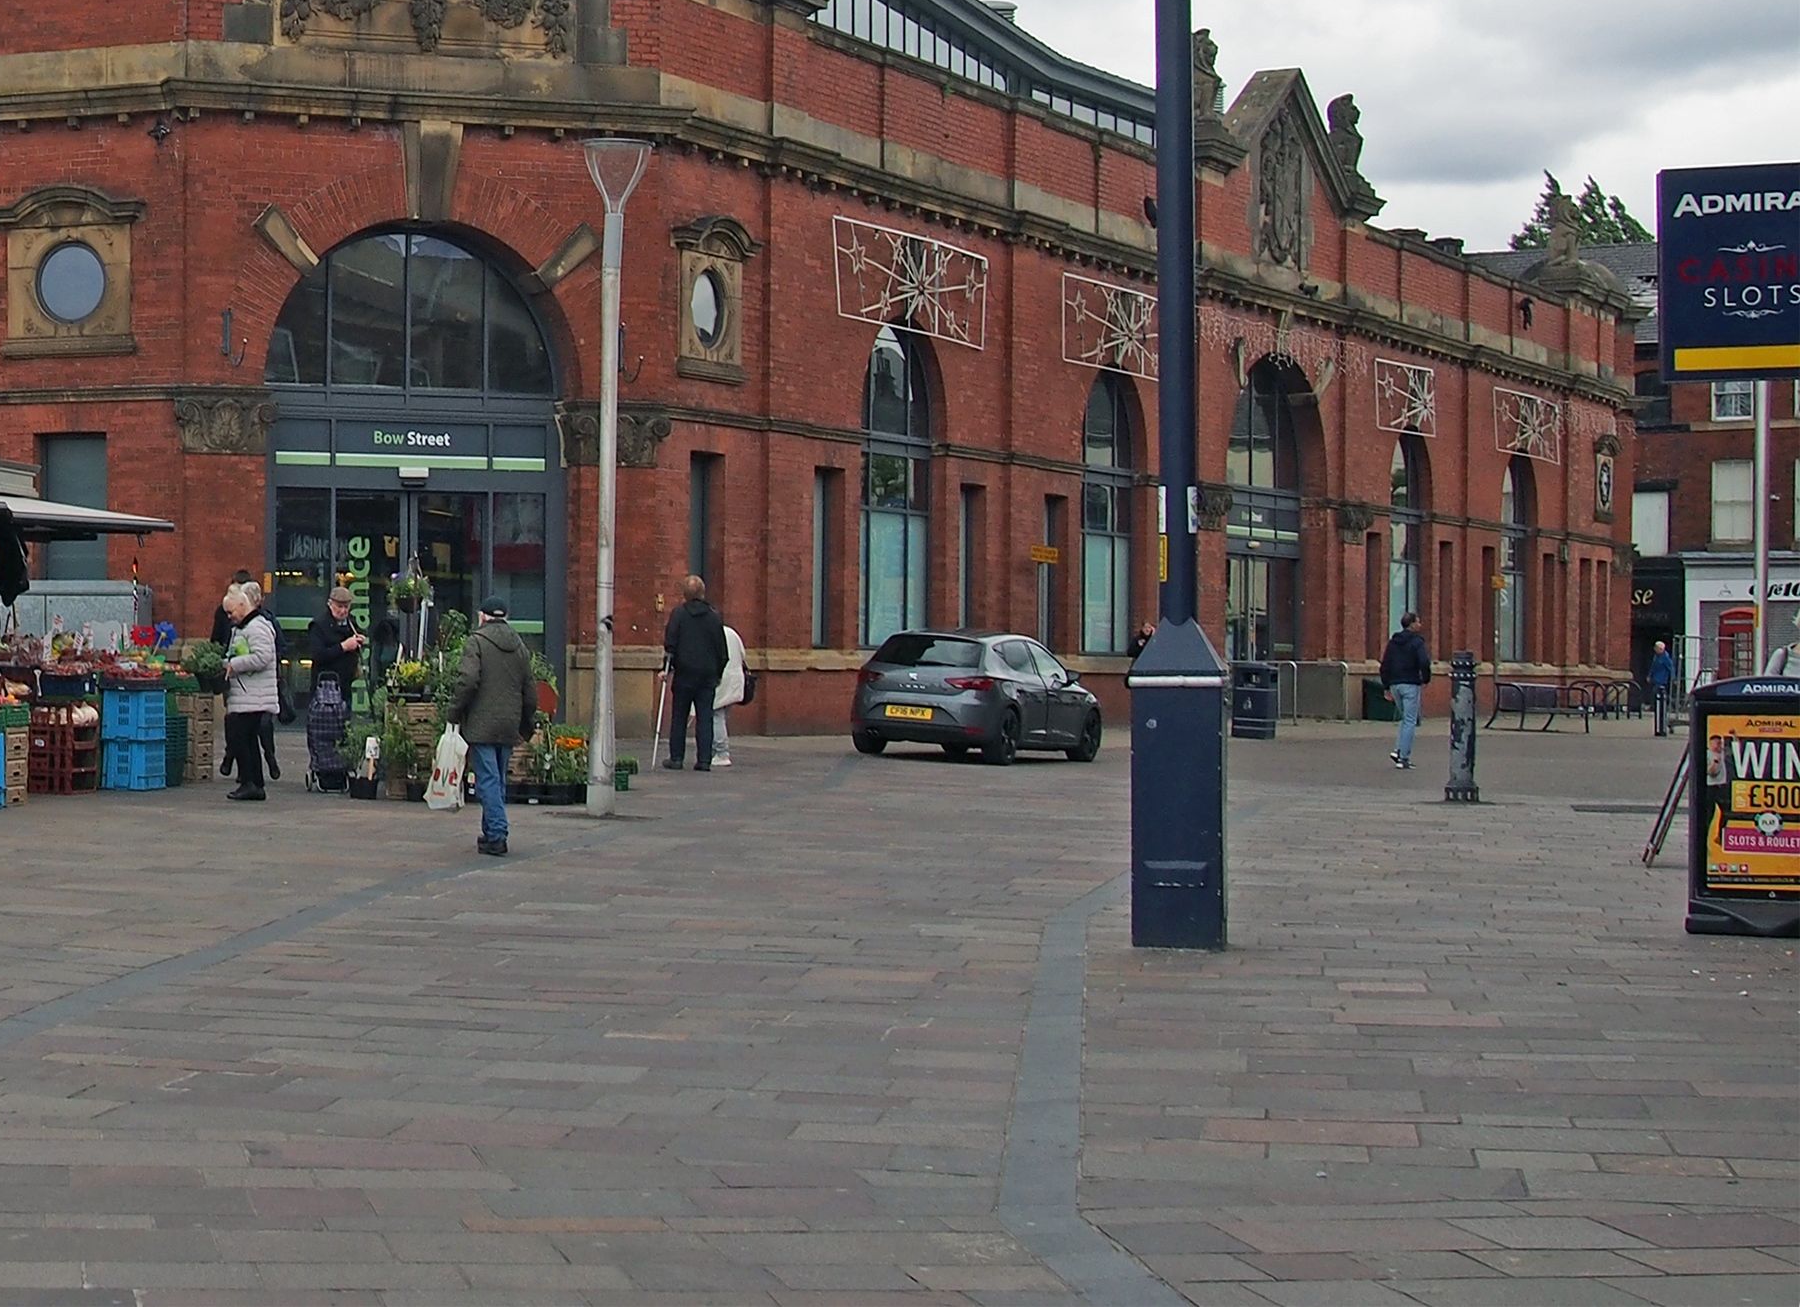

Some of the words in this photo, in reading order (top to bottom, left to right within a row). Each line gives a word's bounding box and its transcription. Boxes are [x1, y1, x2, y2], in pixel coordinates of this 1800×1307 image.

[1704, 284, 1800, 308] SLOTS
[374, 431, 403, 444] Bow
[407, 432, 450, 447] Street
[1741, 683, 1800, 695] ADMIRAL
[1745, 719, 1797, 729] ADMIRAL
[1728, 835, 1756, 846] SLOTS
[1758, 837, 1765, 847] &
